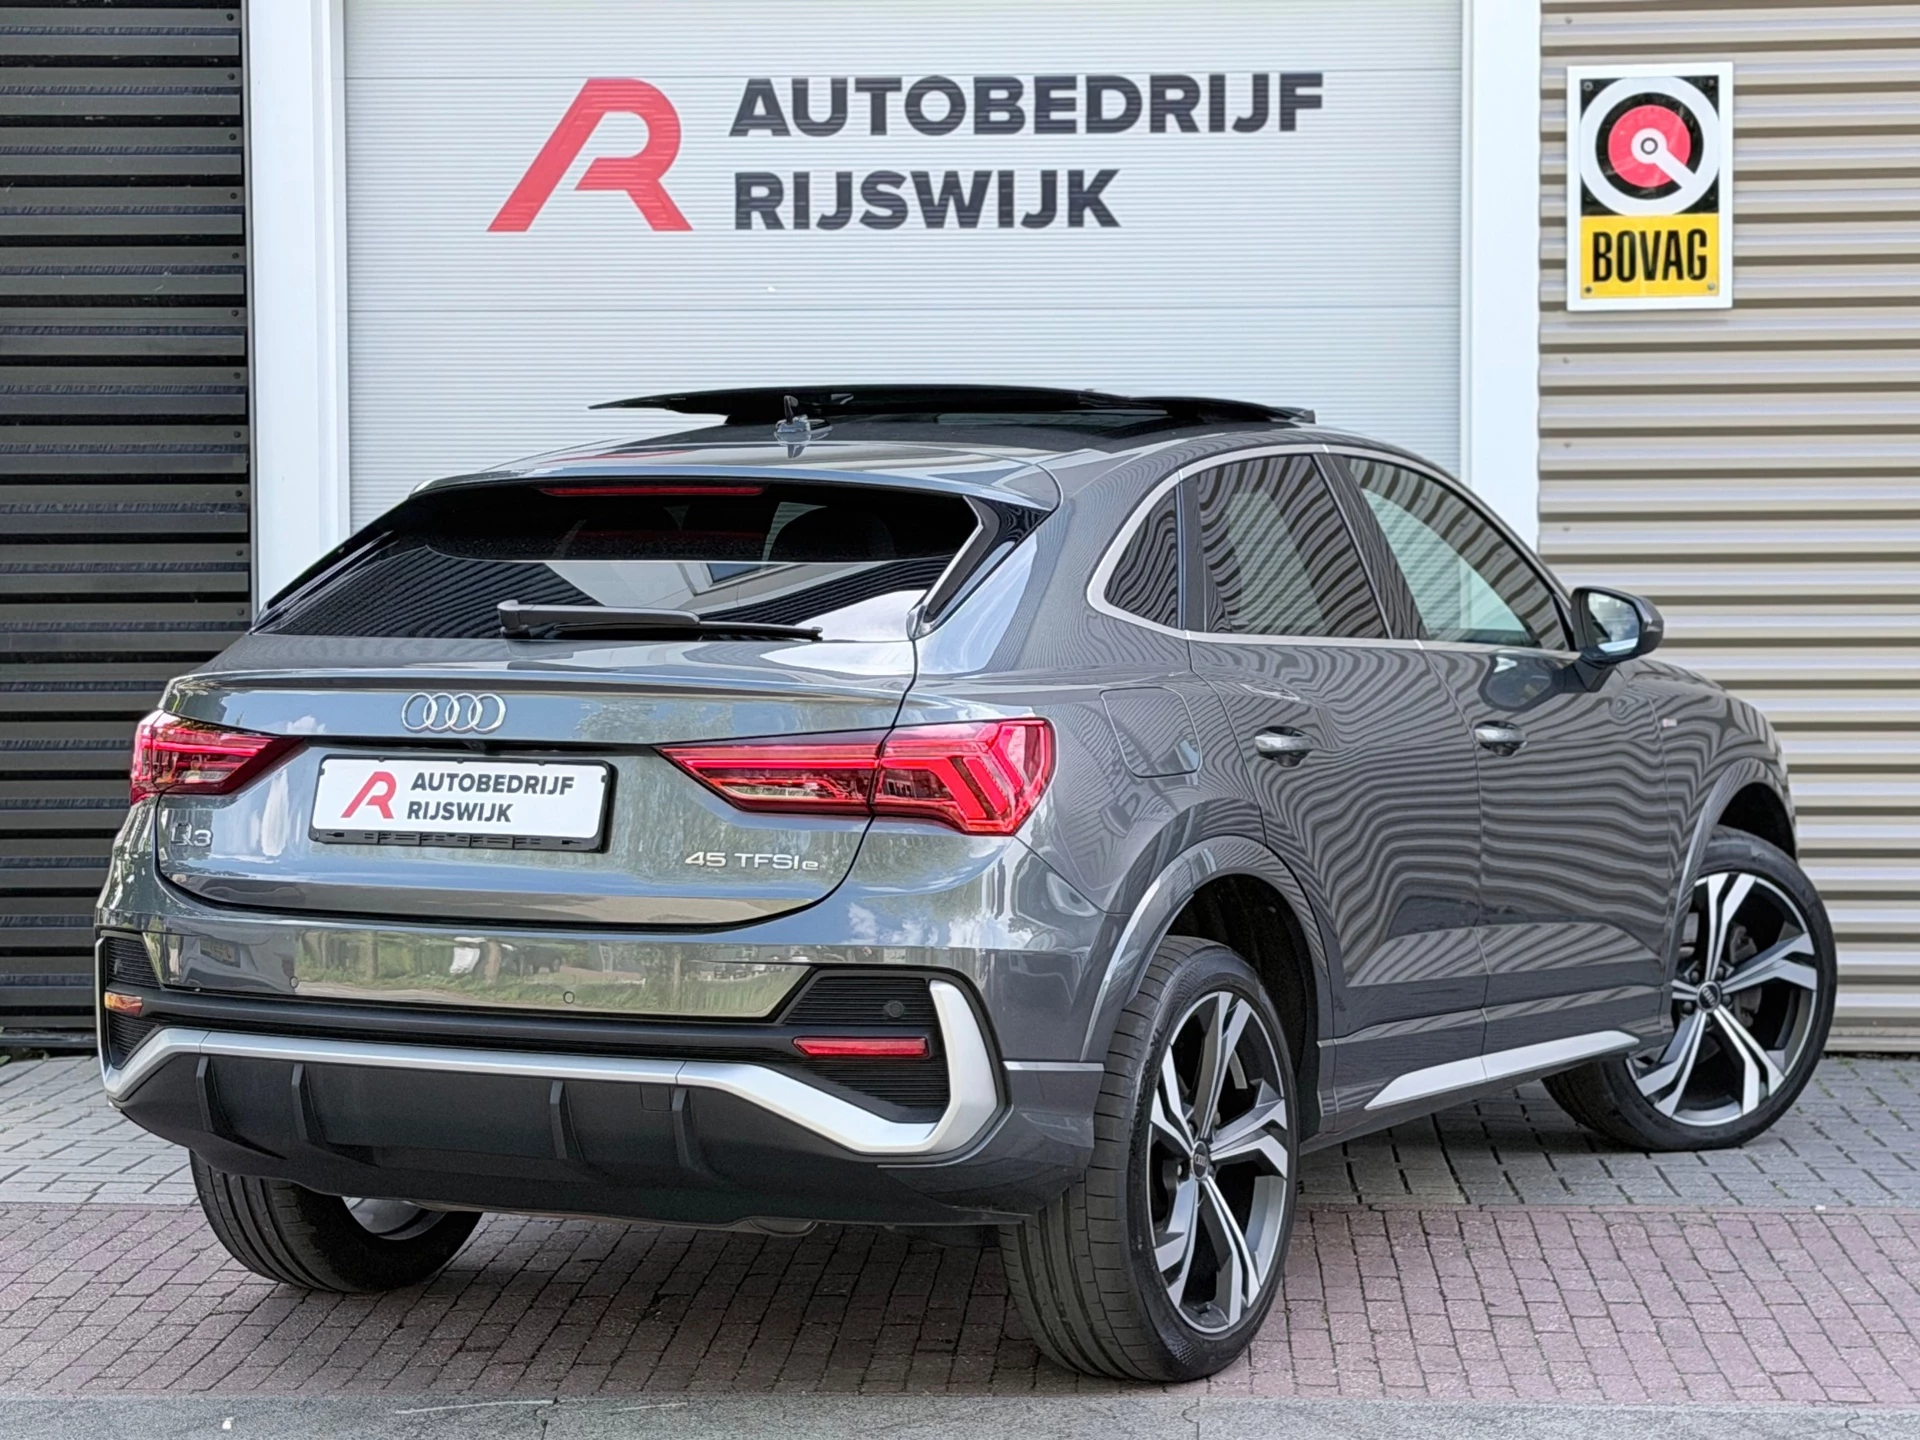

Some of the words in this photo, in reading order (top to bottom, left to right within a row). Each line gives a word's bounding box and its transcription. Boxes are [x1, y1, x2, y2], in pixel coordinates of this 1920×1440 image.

[729, 73, 1324, 137] AUTOBEDRIJF
[735, 168, 1121, 231] RIJSWIJK
[1593, 228, 1708, 283] BOVAG
[410, 772, 575, 795] AUTOBEDRIJF
[406, 801, 514, 823] RIJSWIJK
[684, 851, 727, 868] 45
